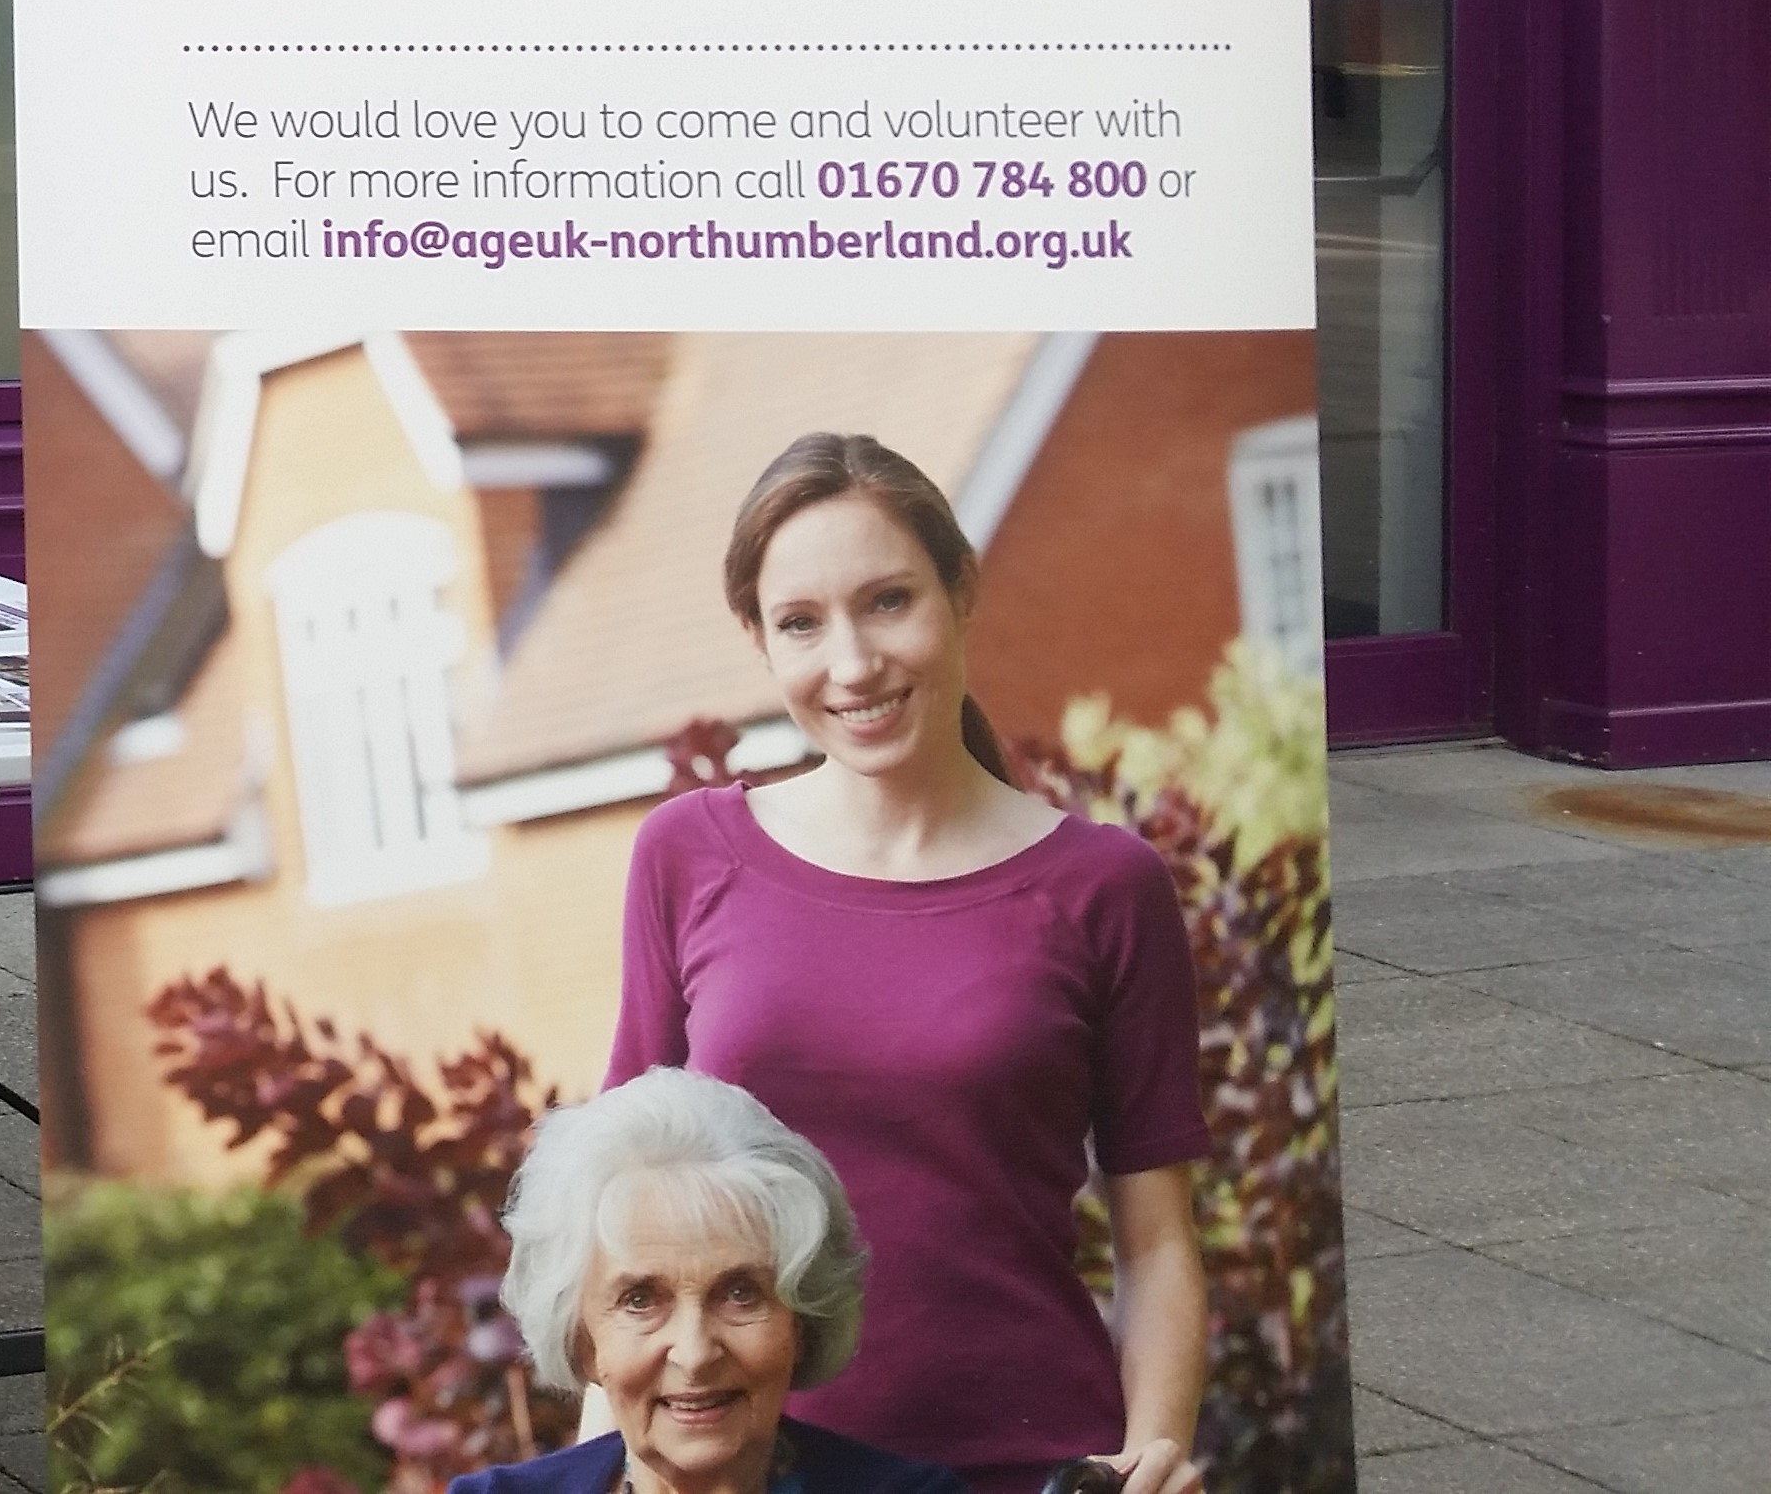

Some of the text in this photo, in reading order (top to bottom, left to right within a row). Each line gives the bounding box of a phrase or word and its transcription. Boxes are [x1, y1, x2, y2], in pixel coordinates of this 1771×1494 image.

[188, 99, 1180, 150] We would love you to come and volunteer with
[192, 159, 1196, 198] us. For more information call 01670 784 800 or
[192, 219, 1132, 269] email info@ageuk-northumberland.org.uk
